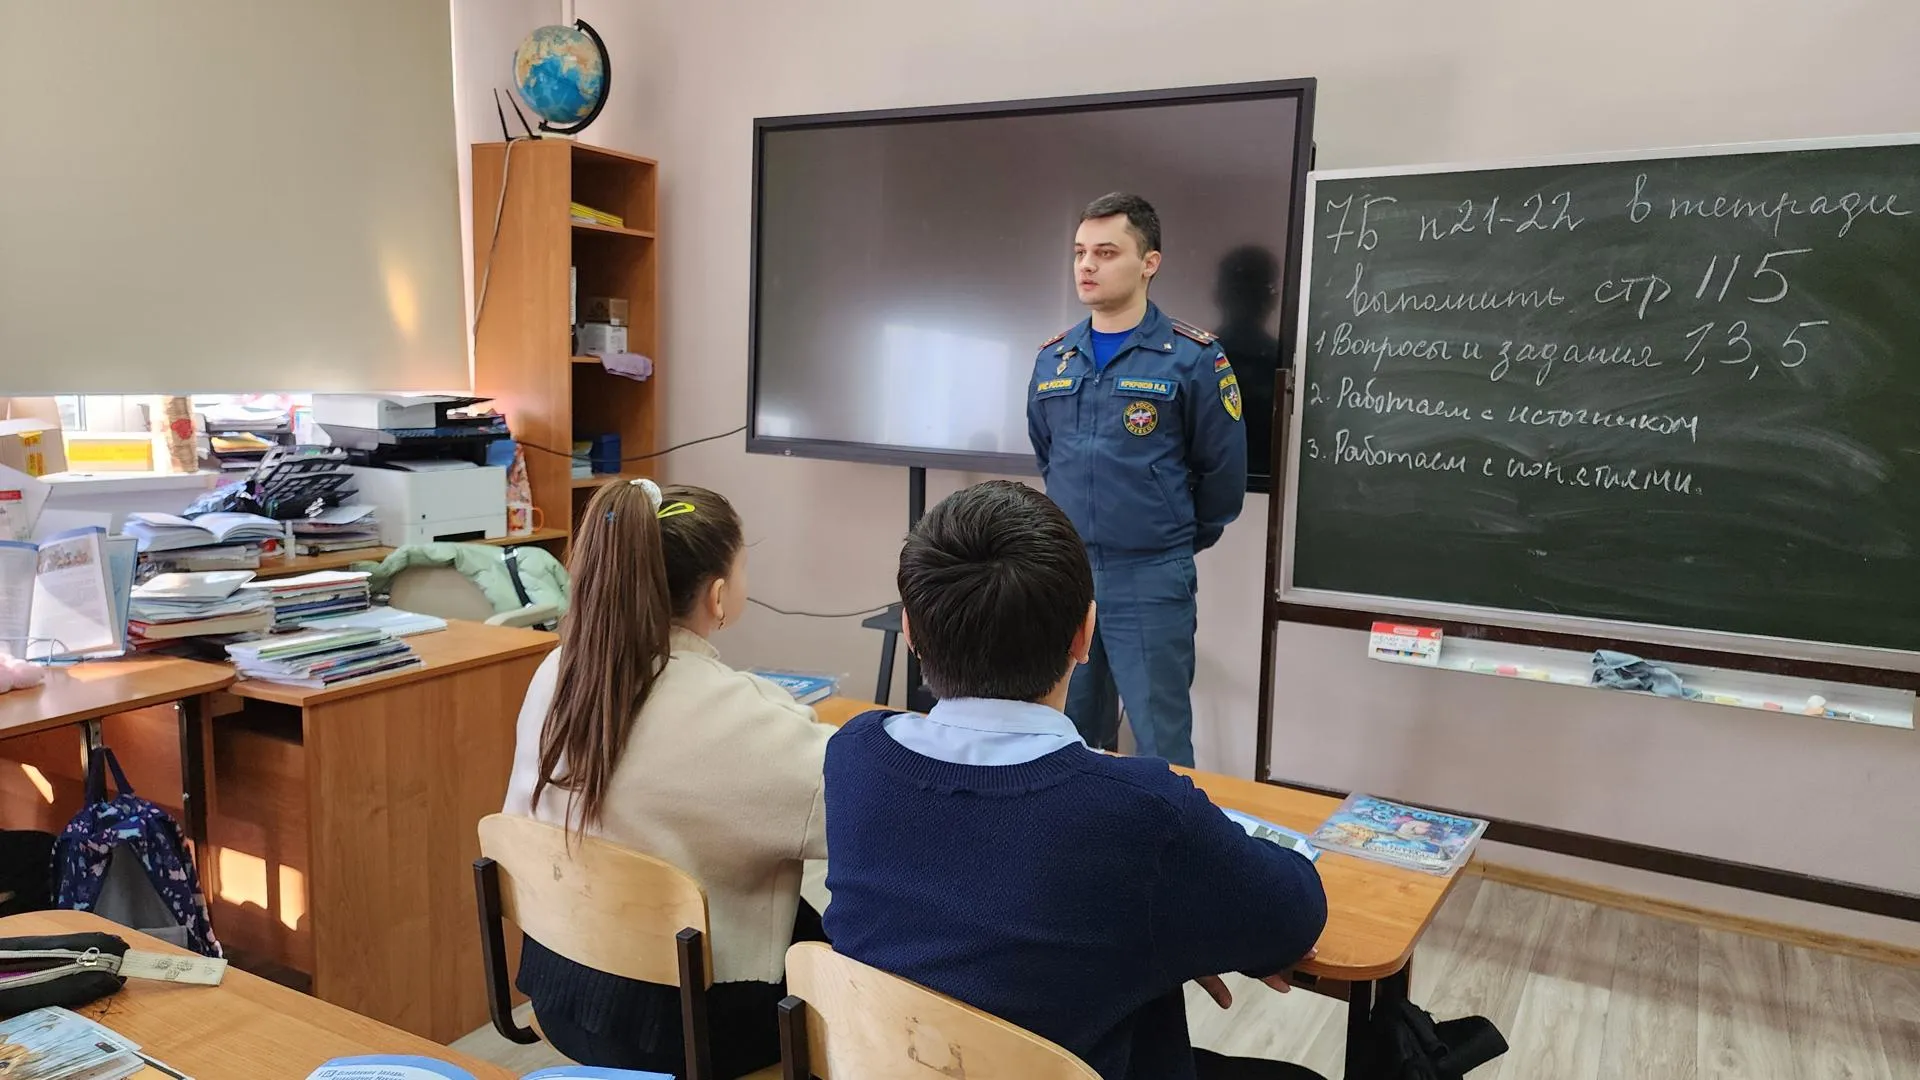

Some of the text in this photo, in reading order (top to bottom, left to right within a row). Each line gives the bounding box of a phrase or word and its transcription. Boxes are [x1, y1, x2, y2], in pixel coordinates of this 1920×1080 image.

[1326, 194, 1397, 254] 7Б
[1626, 173, 1651, 223] в
[1345, 248, 1813, 319] выполнить стр 115
[1463, 341, 1483, 359] и
[1490, 340, 1662, 386] задания
[1781, 320, 1829, 368] 5
[1336, 376, 1471, 420] Работаем
[1481, 409, 1494, 420] с
[1508, 406, 1699, 444] источником
[1334, 428, 1466, 473] Работаем
[1483, 457, 1495, 477] с
